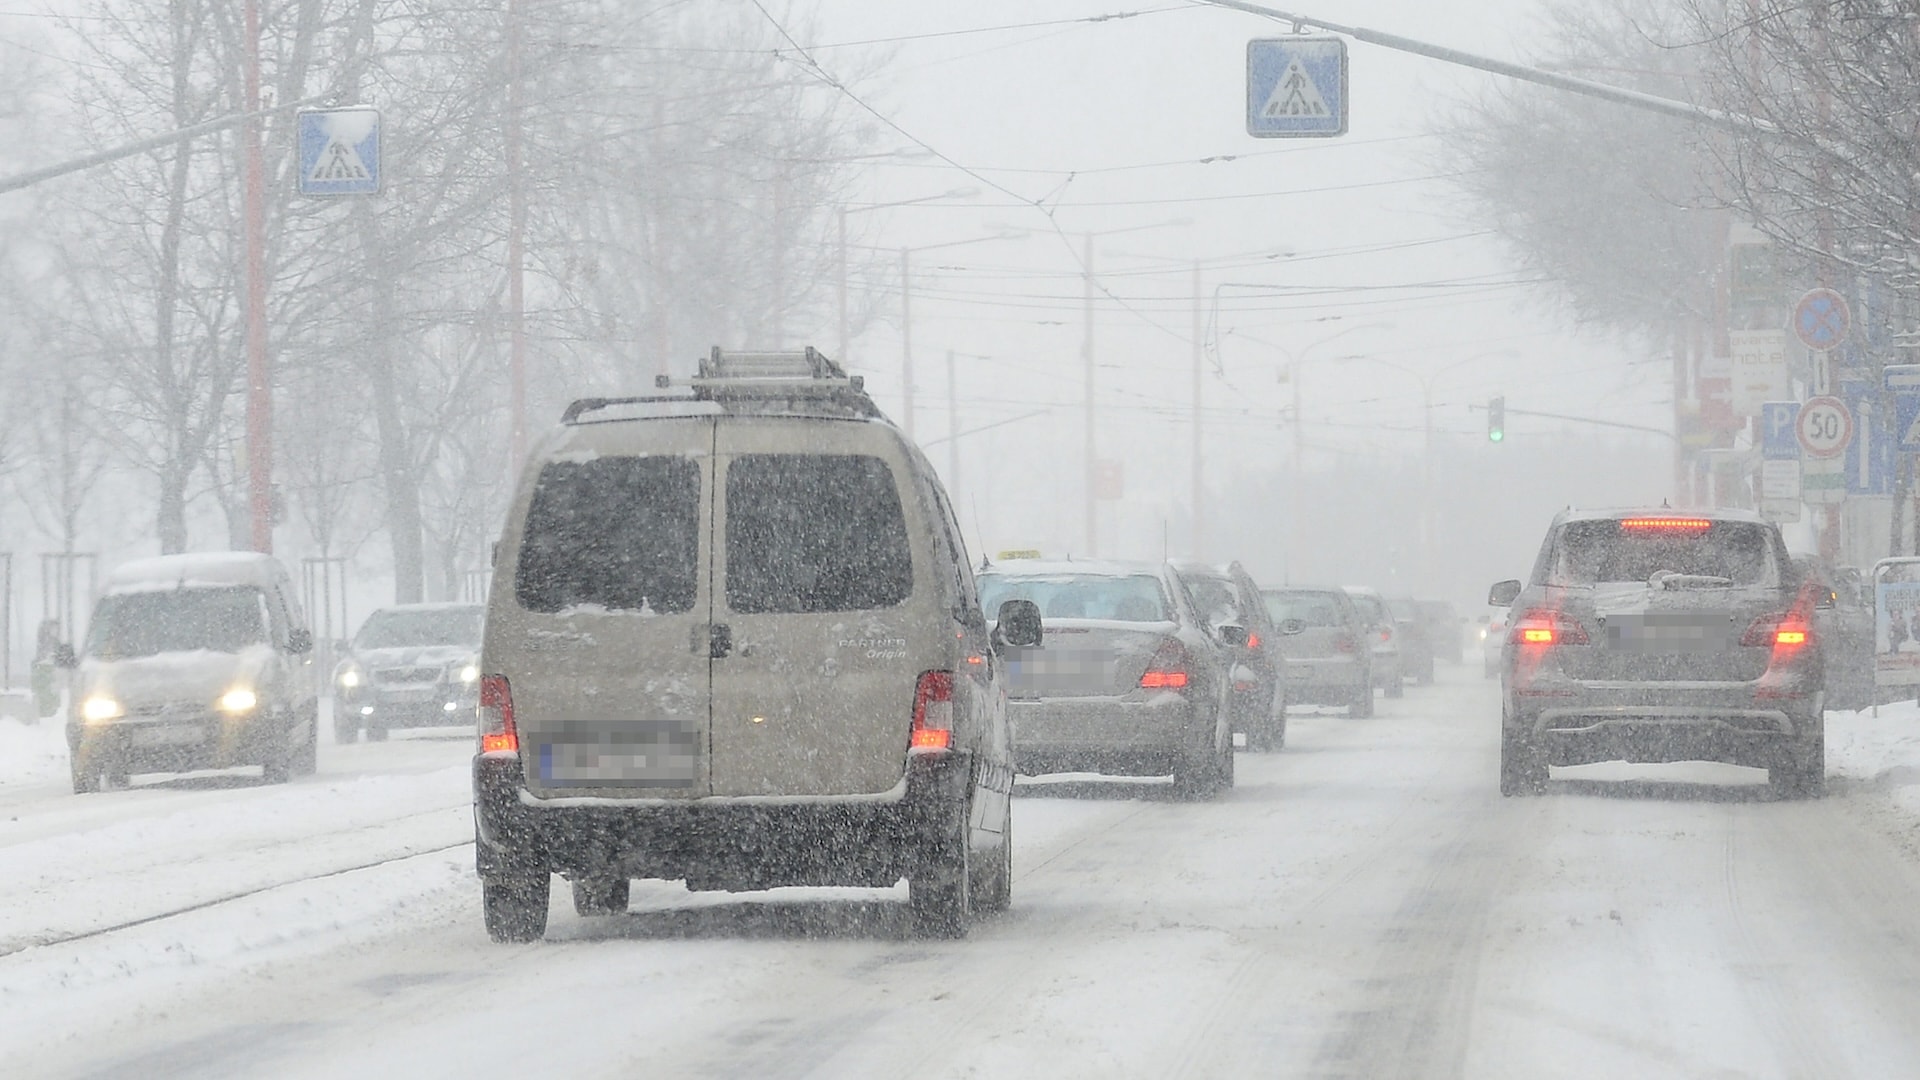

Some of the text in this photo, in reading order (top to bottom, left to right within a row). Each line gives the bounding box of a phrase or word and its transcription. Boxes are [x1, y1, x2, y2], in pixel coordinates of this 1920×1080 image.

[1731, 348, 1786, 365] hotel
[1773, 406, 1790, 438] P
[1810, 412, 1838, 440] 50
[838, 638, 906, 649] PARTNER
[866, 648, 906, 659] Origin
